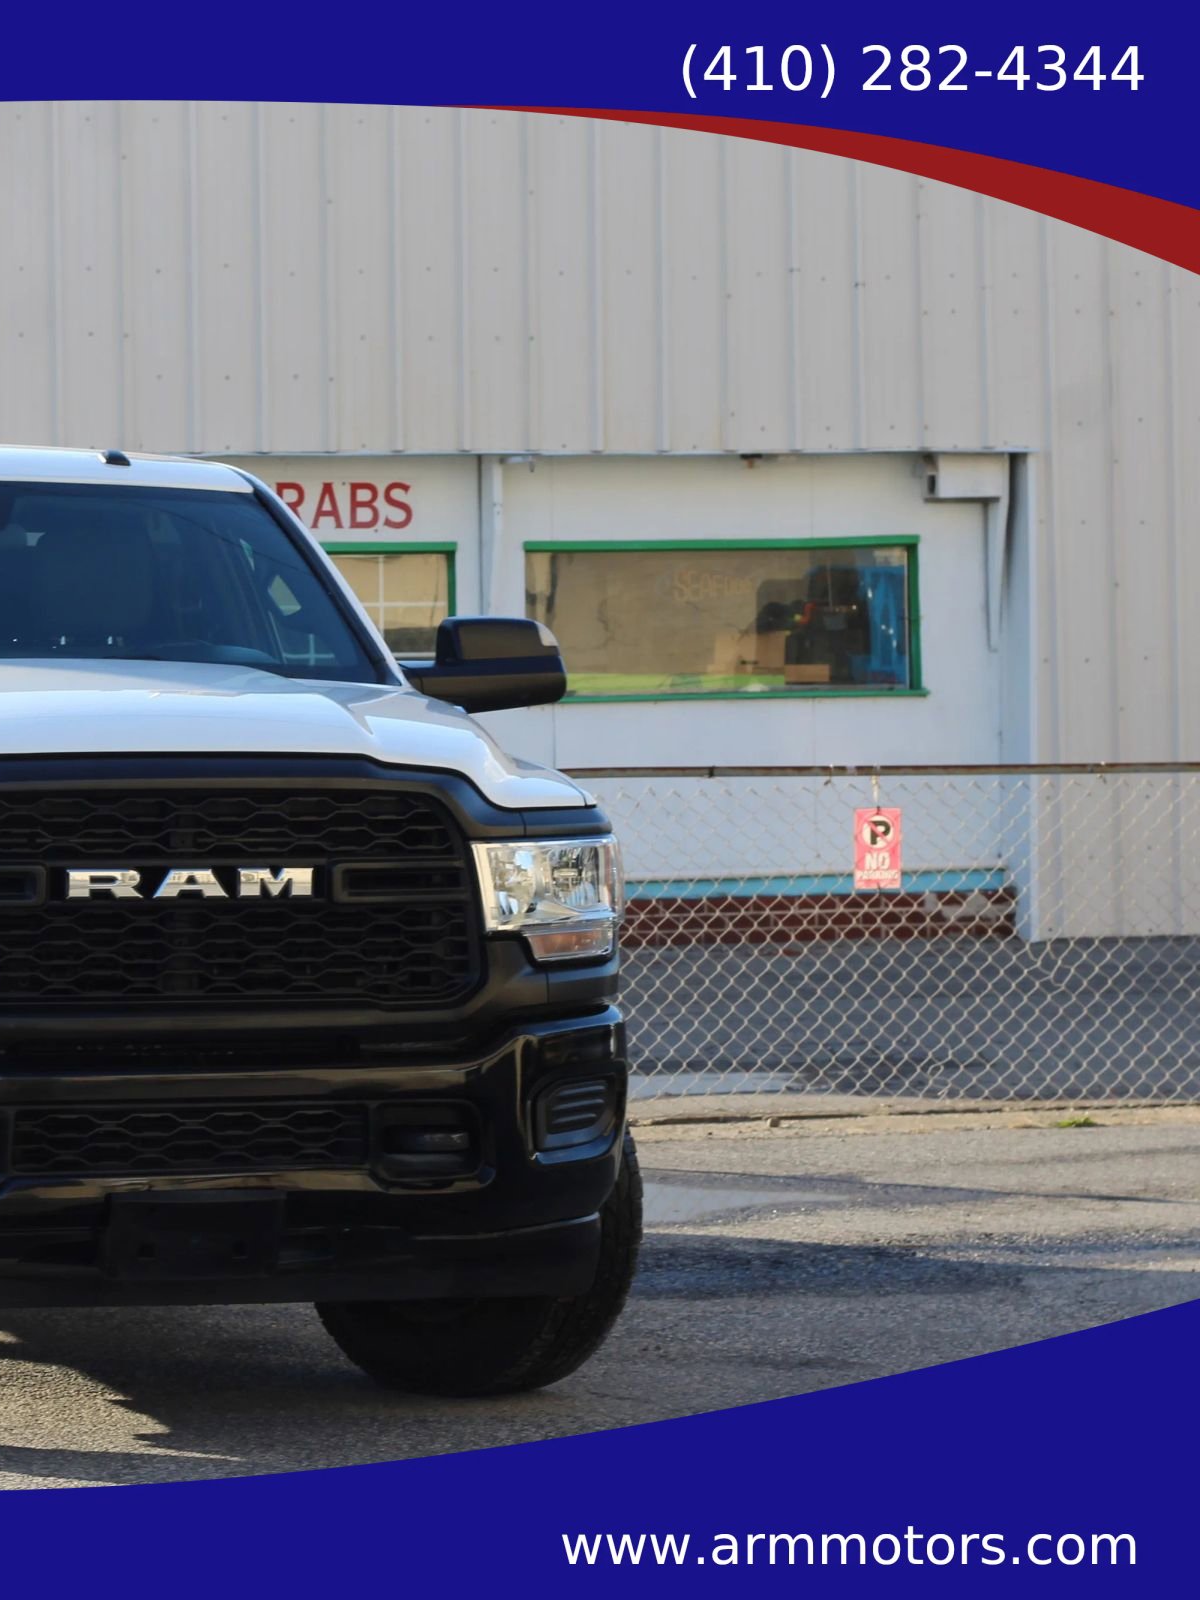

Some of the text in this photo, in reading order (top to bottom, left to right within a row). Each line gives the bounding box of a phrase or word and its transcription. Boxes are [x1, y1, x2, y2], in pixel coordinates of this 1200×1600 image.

[275, 482, 413, 529] RABS
[864, 851, 890, 870] NO
[66, 867, 314, 898] RAM
